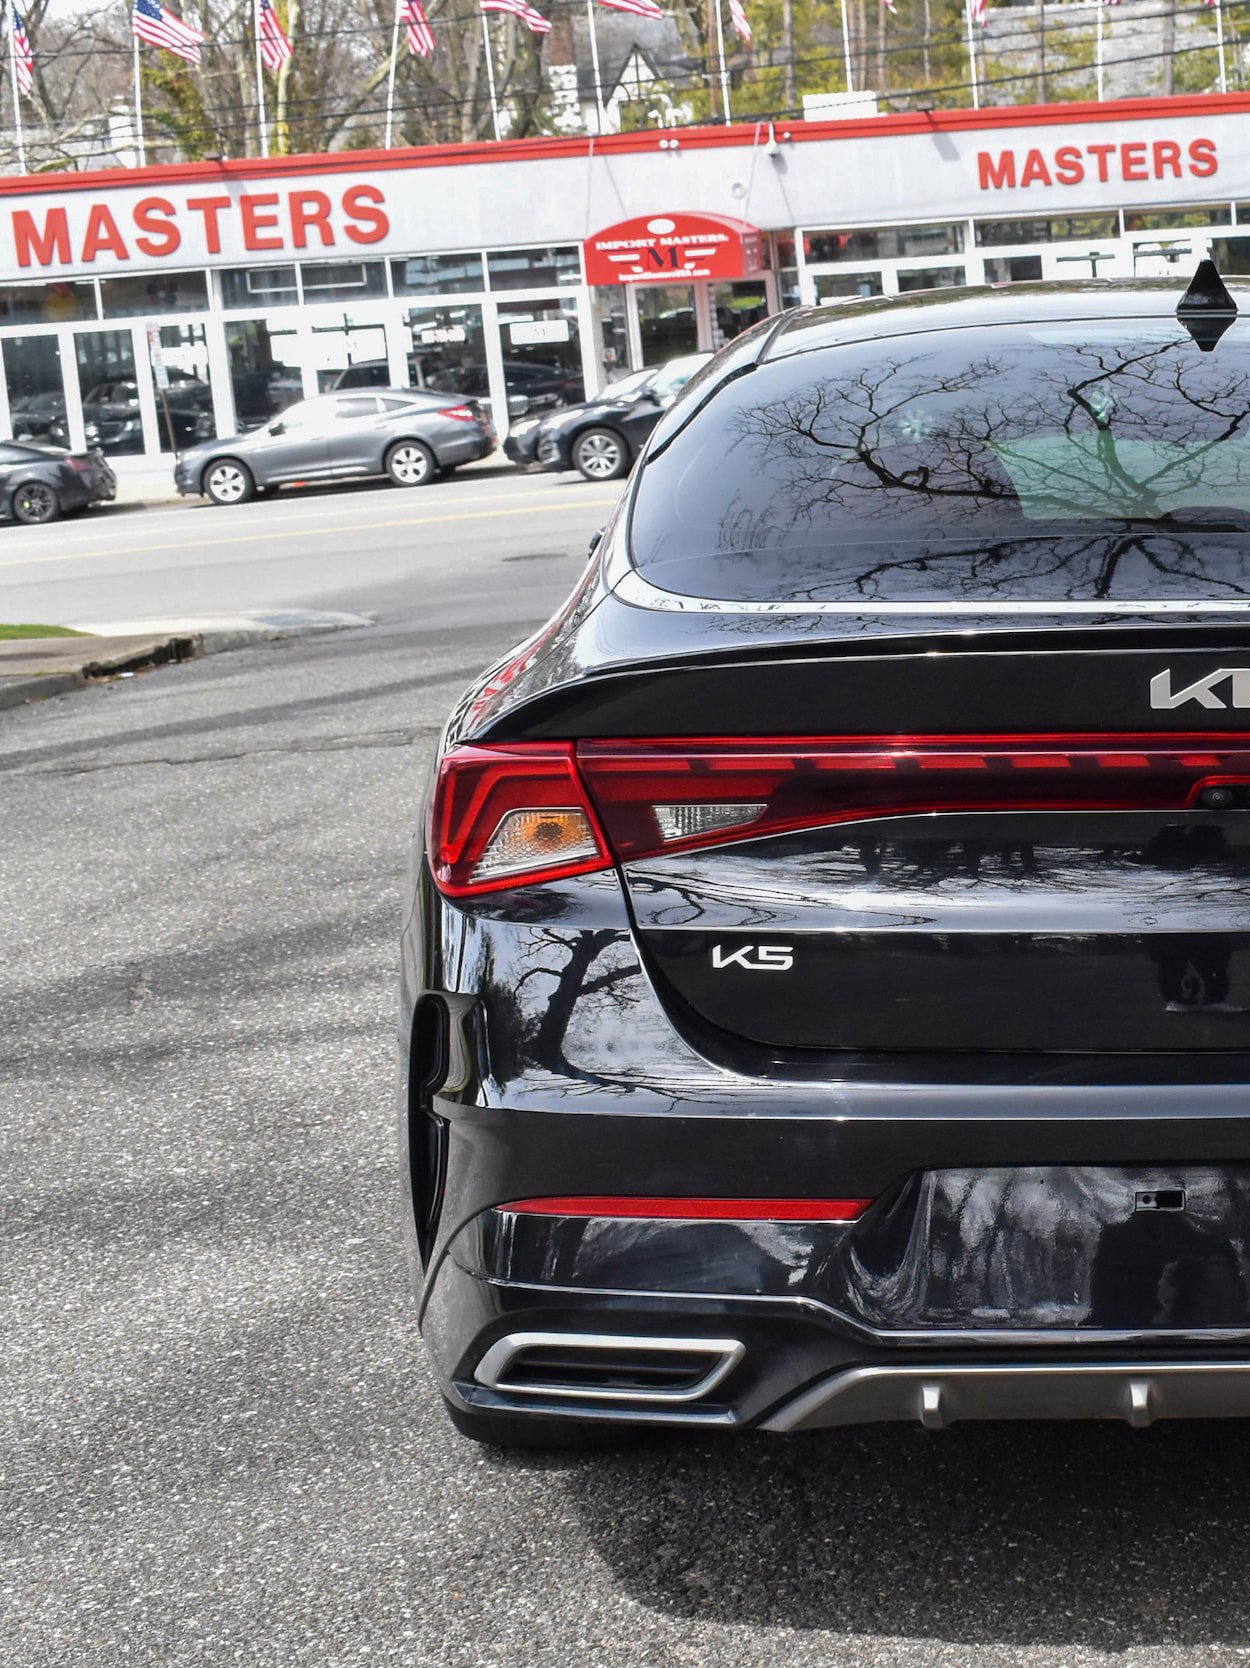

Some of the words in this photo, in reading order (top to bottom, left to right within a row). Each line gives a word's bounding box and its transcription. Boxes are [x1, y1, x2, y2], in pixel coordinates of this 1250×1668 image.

[977, 138, 1218, 190] MASTERS
[12, 184, 390, 267] MASTERS
[596, 239, 656, 250] IMPORT
[712, 944, 794, 970] K5
